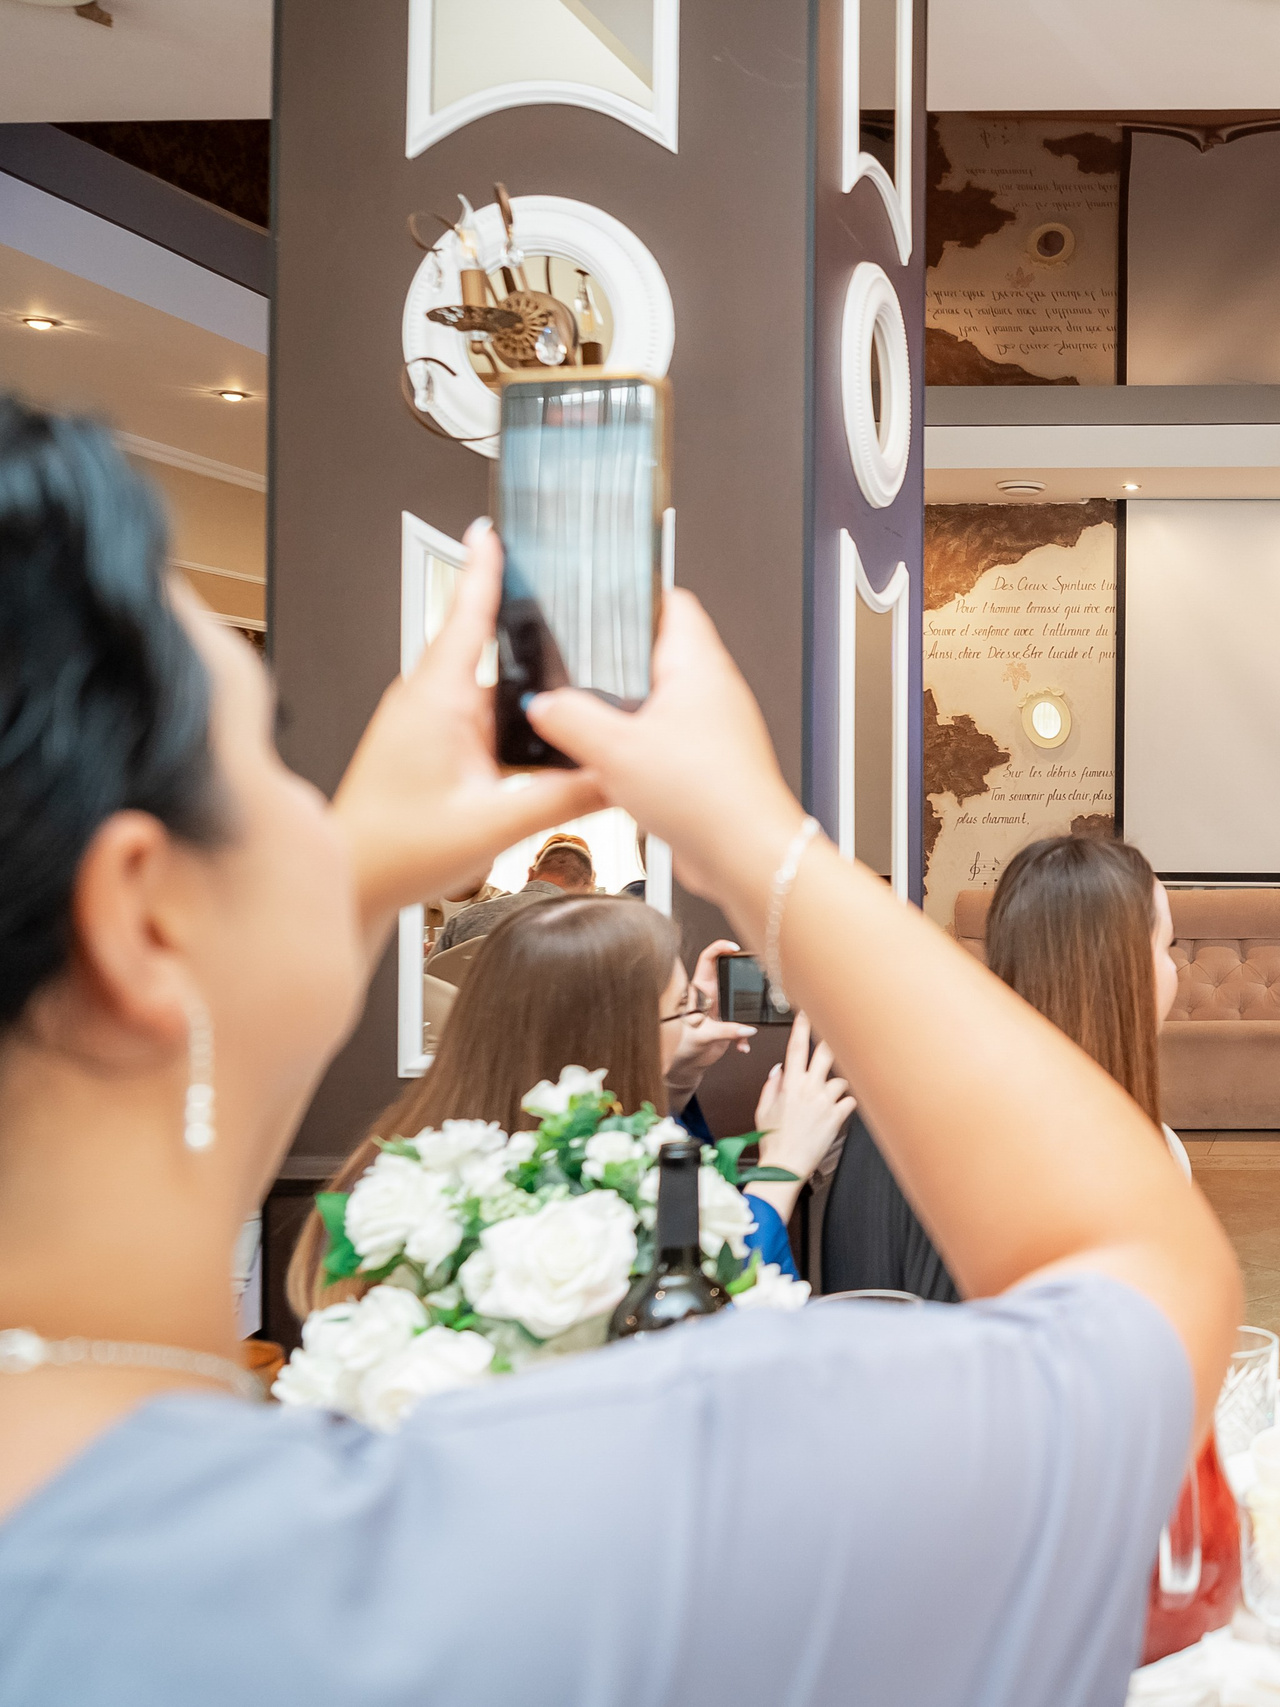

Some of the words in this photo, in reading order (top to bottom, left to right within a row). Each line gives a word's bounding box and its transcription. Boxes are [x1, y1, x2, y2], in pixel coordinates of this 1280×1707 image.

[992, 576, 1014, 590] Des
[1017, 576, 1047, 590] Cieux
[955, 599, 977, 613] Pour
[1064, 604, 1081, 620] qui
[960, 623, 970, 636] et
[1095, 624, 1109, 636] du
[1048, 646, 1079, 659] lucide
[1082, 646, 1094, 659] et
[1003, 763, 1023, 778] Sur
[1029, 765, 1042, 778] les
[991, 787, 1006, 801] Ton
[1009, 791, 1045, 801] souvenir
[1045, 789, 1066, 807] plus
[1091, 789, 1113, 806] plus
[954, 812, 977, 831] plus
